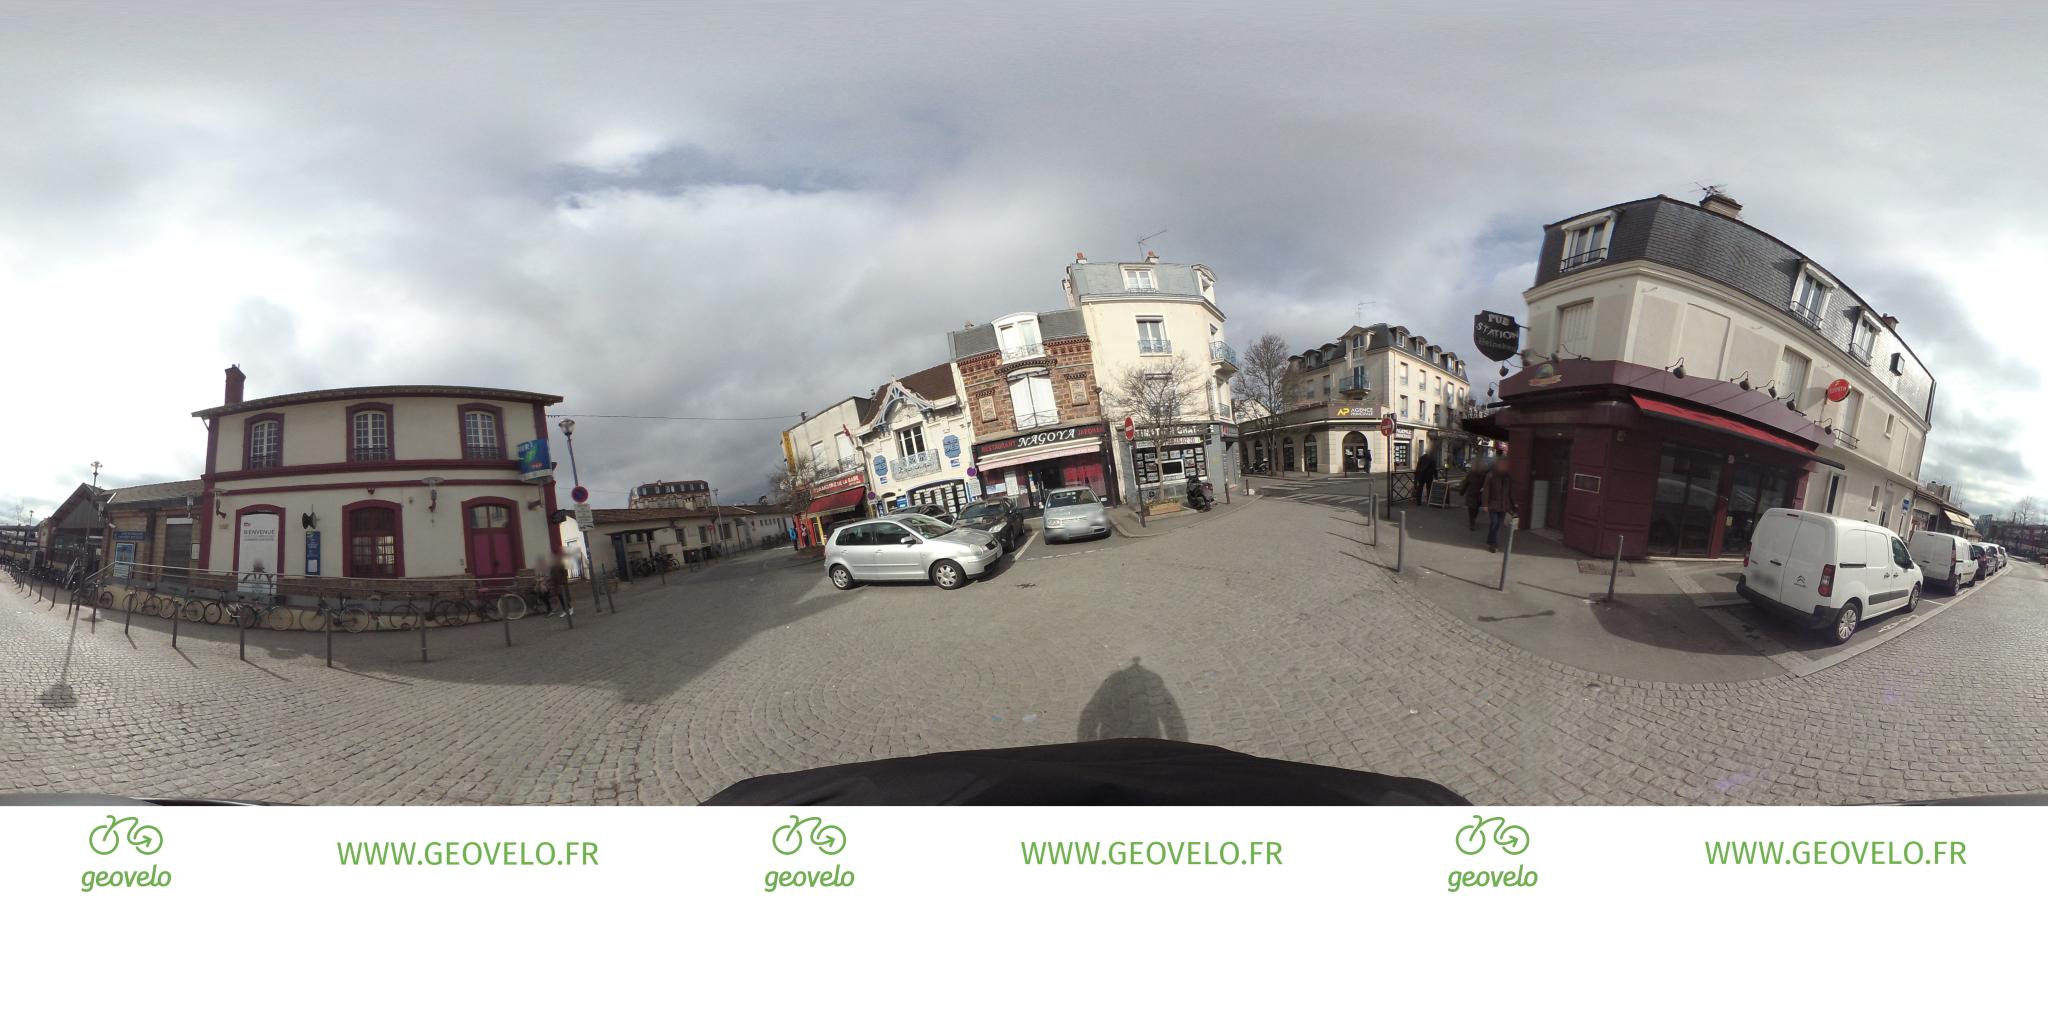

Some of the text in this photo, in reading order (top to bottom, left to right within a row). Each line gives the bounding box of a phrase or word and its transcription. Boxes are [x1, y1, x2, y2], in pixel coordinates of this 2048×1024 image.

[1488, 313, 1511, 326] PUB
[1337, 407, 1350, 416] AP
[1017, 428, 1075, 447] NAGOYA
